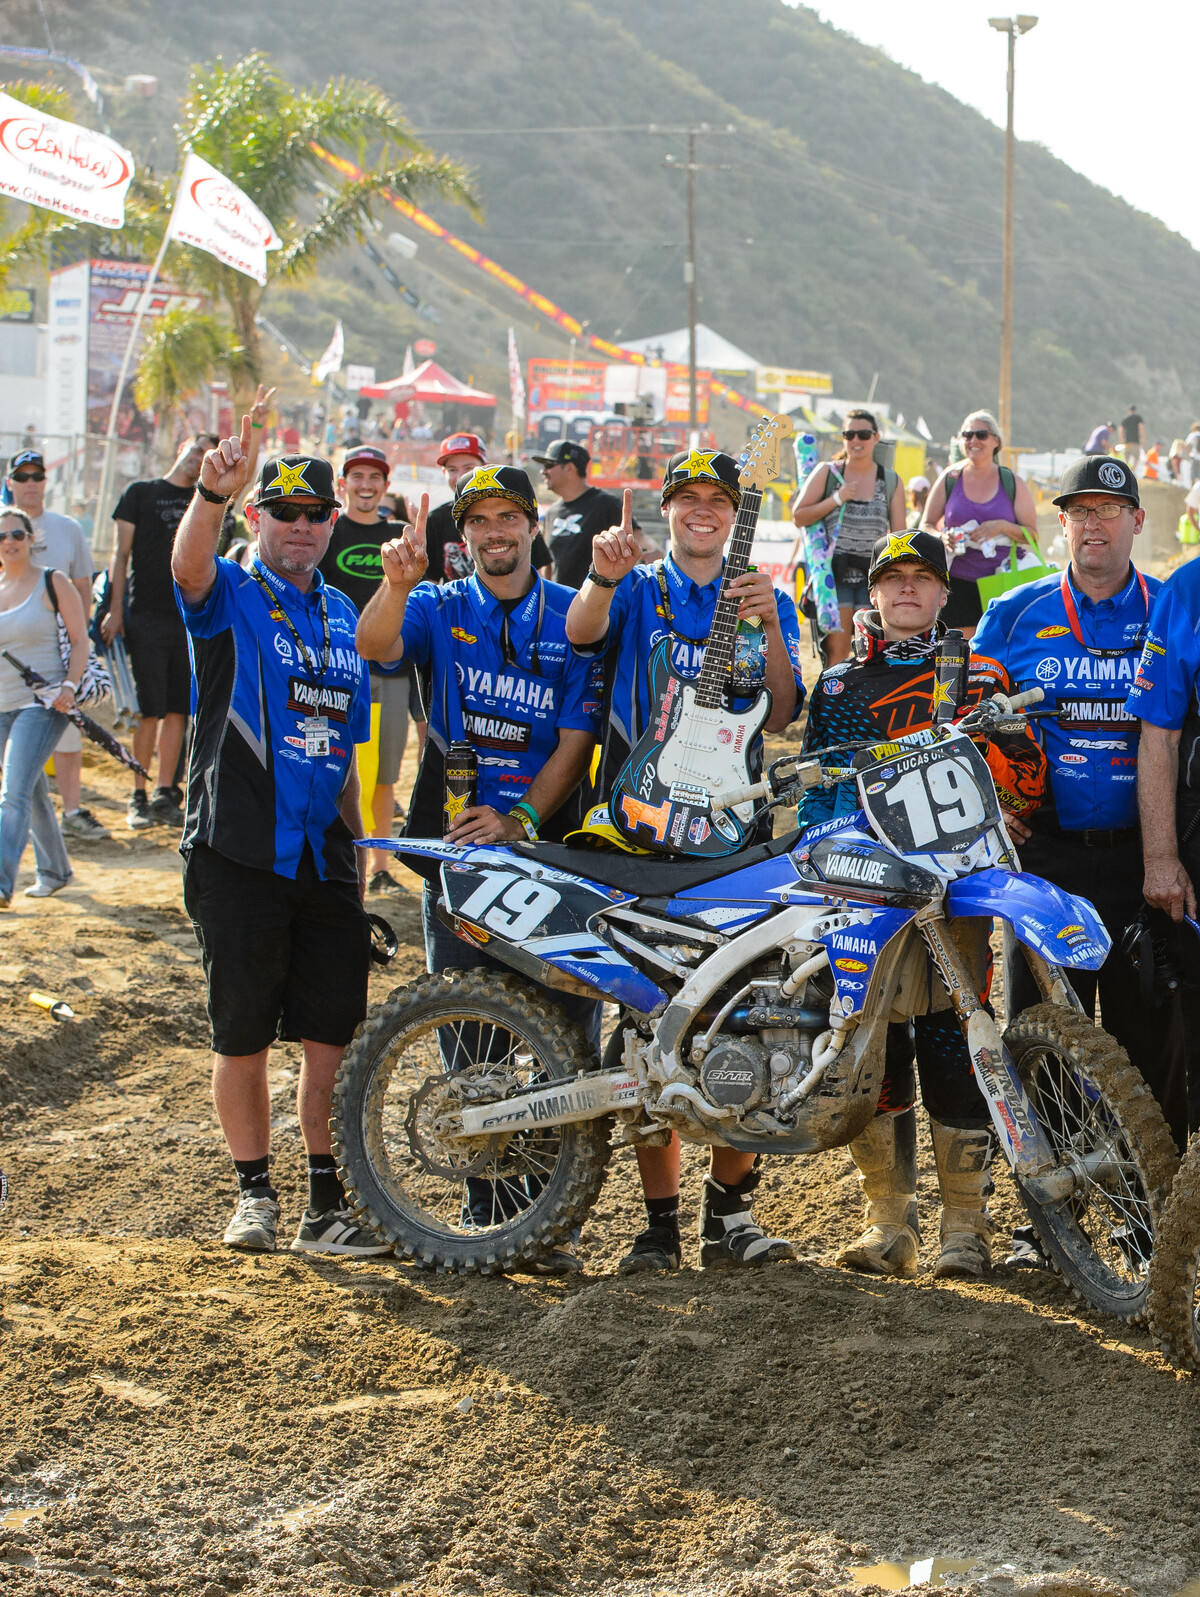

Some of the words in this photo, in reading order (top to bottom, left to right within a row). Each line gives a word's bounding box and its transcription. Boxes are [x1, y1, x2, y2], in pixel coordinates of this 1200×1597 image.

[346, 555, 383, 566] FM
[264, 569, 286, 592] YAMAHA
[525, 592, 537, 620] YAMAHA
[467, 667, 554, 710] YAMAHA
[824, 679, 837, 695] VP
[462, 711, 526, 742] YAMALUBE
[733, 725, 746, 754] YAMAHA
[900, 731, 933, 750] TAPER
[329, 746, 346, 758] KYB
[1062, 755, 1085, 763] BELL
[897, 754, 929, 773] LUCAS
[500, 774, 532, 784] KYB
[639, 763, 656, 800] 250
[885, 756, 986, 848] 19
[621, 794, 674, 846] 1
[806, 813, 856, 841] YAMAHA
[832, 843, 875, 857] GYTR
[825, 854, 887, 884] YAMALUBE
[457, 870, 561, 940] 19
[832, 933, 877, 955] YAMAHA
[1066, 944, 1107, 964] YAMAHA
[577, 967, 600, 983] MARTIN
[836, 960, 868, 972] FMF
[707, 1070, 753, 1080] GYTR
[973, 1051, 999, 1098] YAMALUBE
[989, 1048, 1035, 1136] DUNLOP
[482, 1110, 528, 1128] GYTR
[995, 1100, 1024, 1153] BRAKING
